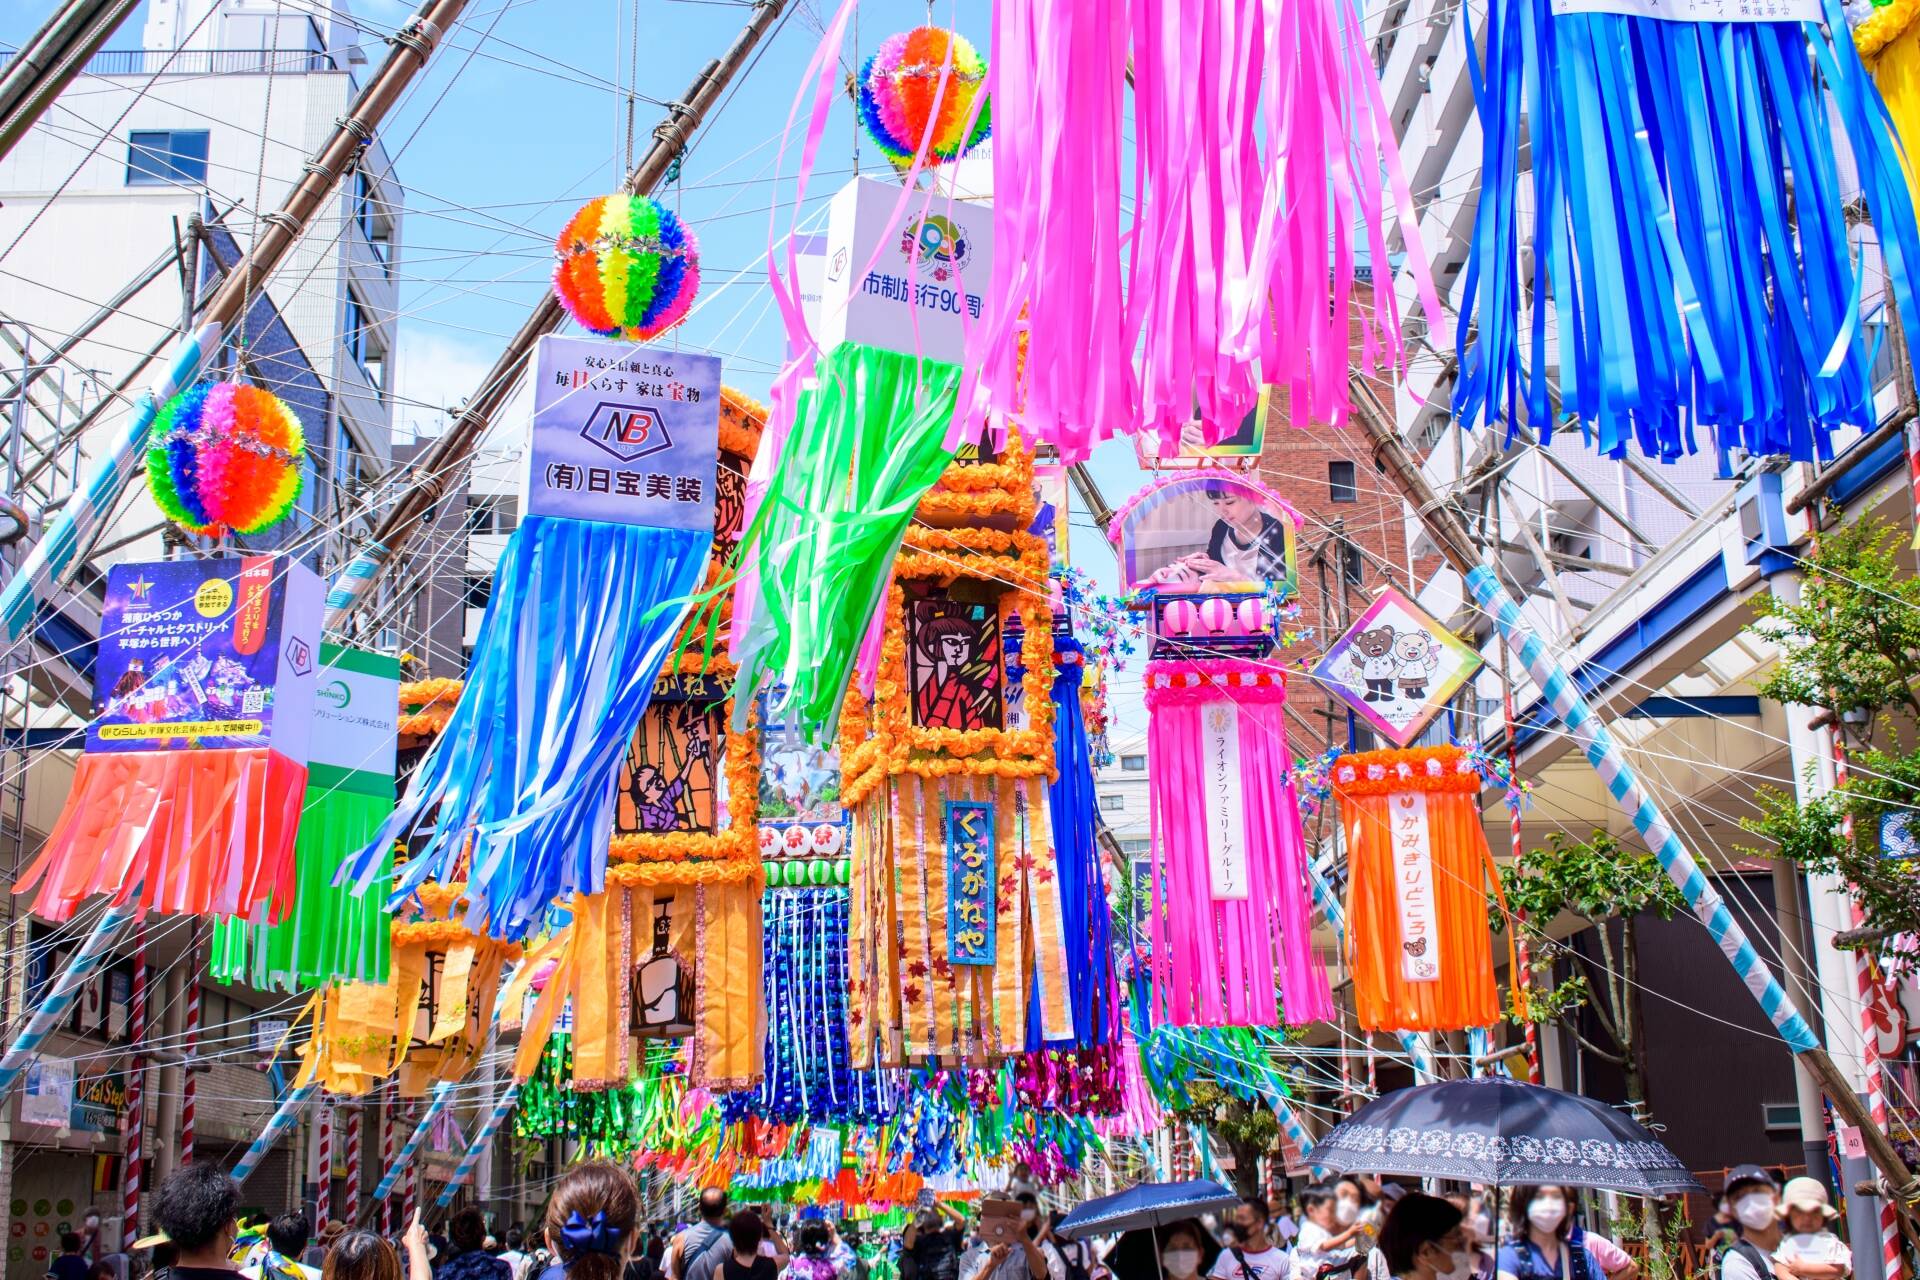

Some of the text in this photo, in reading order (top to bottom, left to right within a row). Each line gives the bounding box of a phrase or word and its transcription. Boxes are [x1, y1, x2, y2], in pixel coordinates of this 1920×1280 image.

[862, 270, 984, 319] 市制施行90周
[583, 355, 675, 378] 安心と信頼と真心
[635, 380, 702, 403] 家は宝物
[602, 410, 654, 445] NB
[545, 463, 703, 503] (有)日宝美装
[291, 643, 307, 667] NB
[959, 811, 986, 956] くろがねや
[1400, 814, 1427, 936] かみきりどころ
[103, 1079, 125, 1115] Step
[1848, 1137, 1860, 1148] 40
